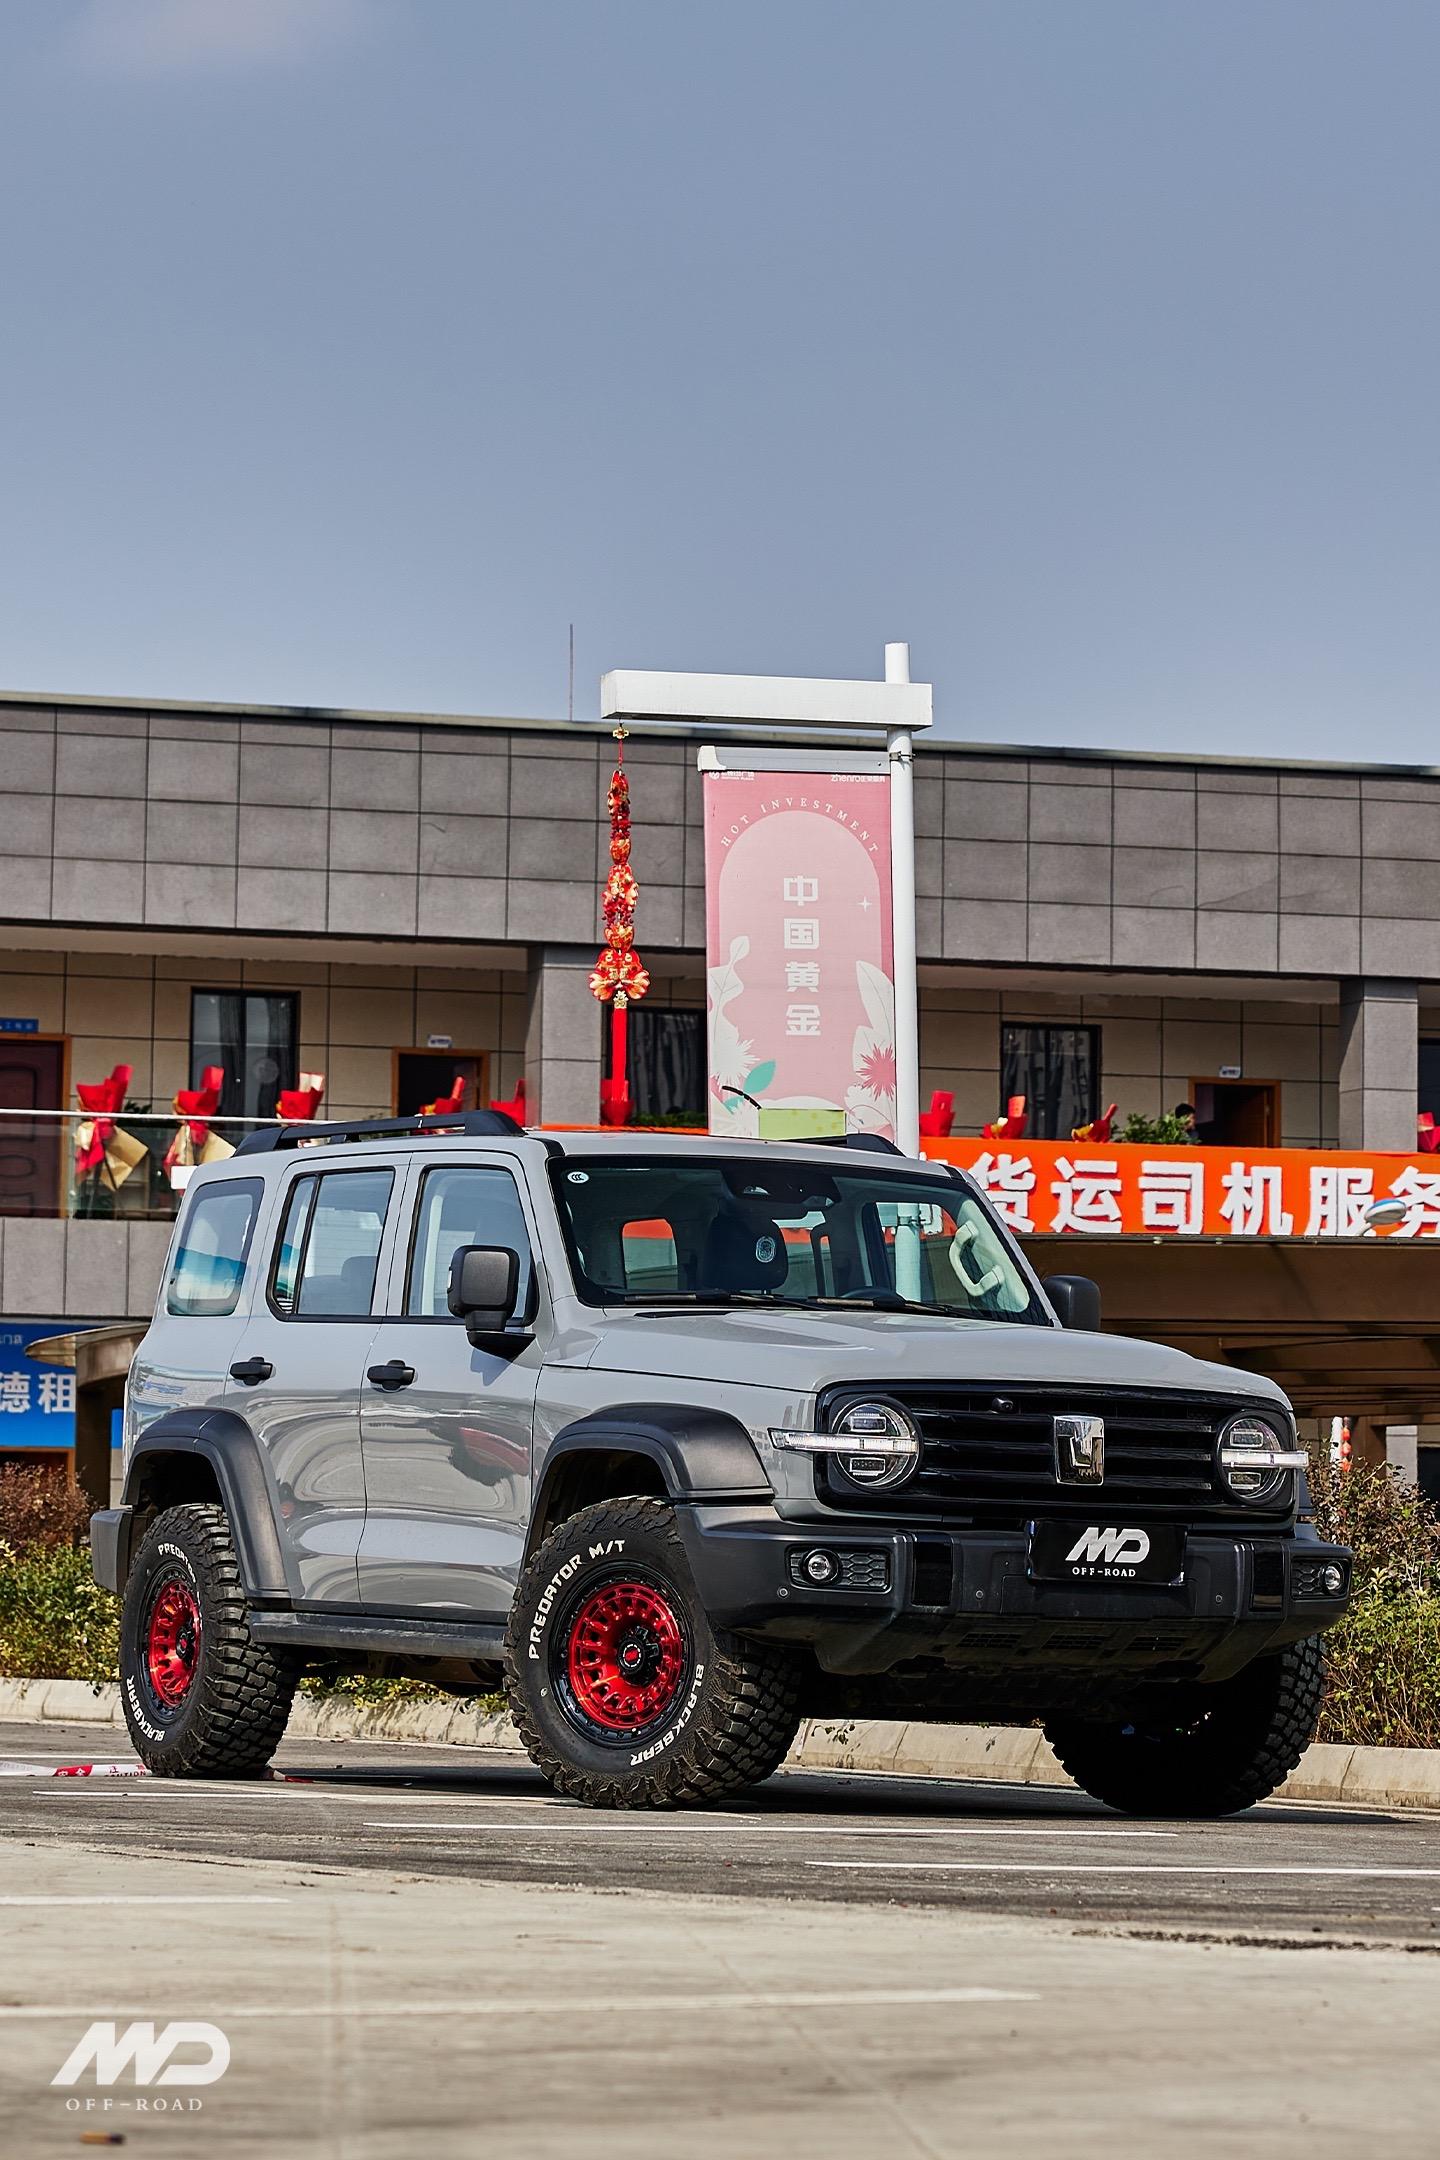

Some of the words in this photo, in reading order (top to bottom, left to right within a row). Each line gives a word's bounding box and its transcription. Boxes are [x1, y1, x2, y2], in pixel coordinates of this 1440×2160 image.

[721, 815, 751, 847] HOT
[760, 797, 879, 853] INVESTMENT
[783, 875, 821, 1036] 中国黄金
[919, 1151, 1440, 1238] 货运司机服务
[528, 1553, 583, 1660] PREDATOR
[588, 1539, 626, 1561] M/T
[1072, 1567, 1137, 1577] OFF-ROAD
